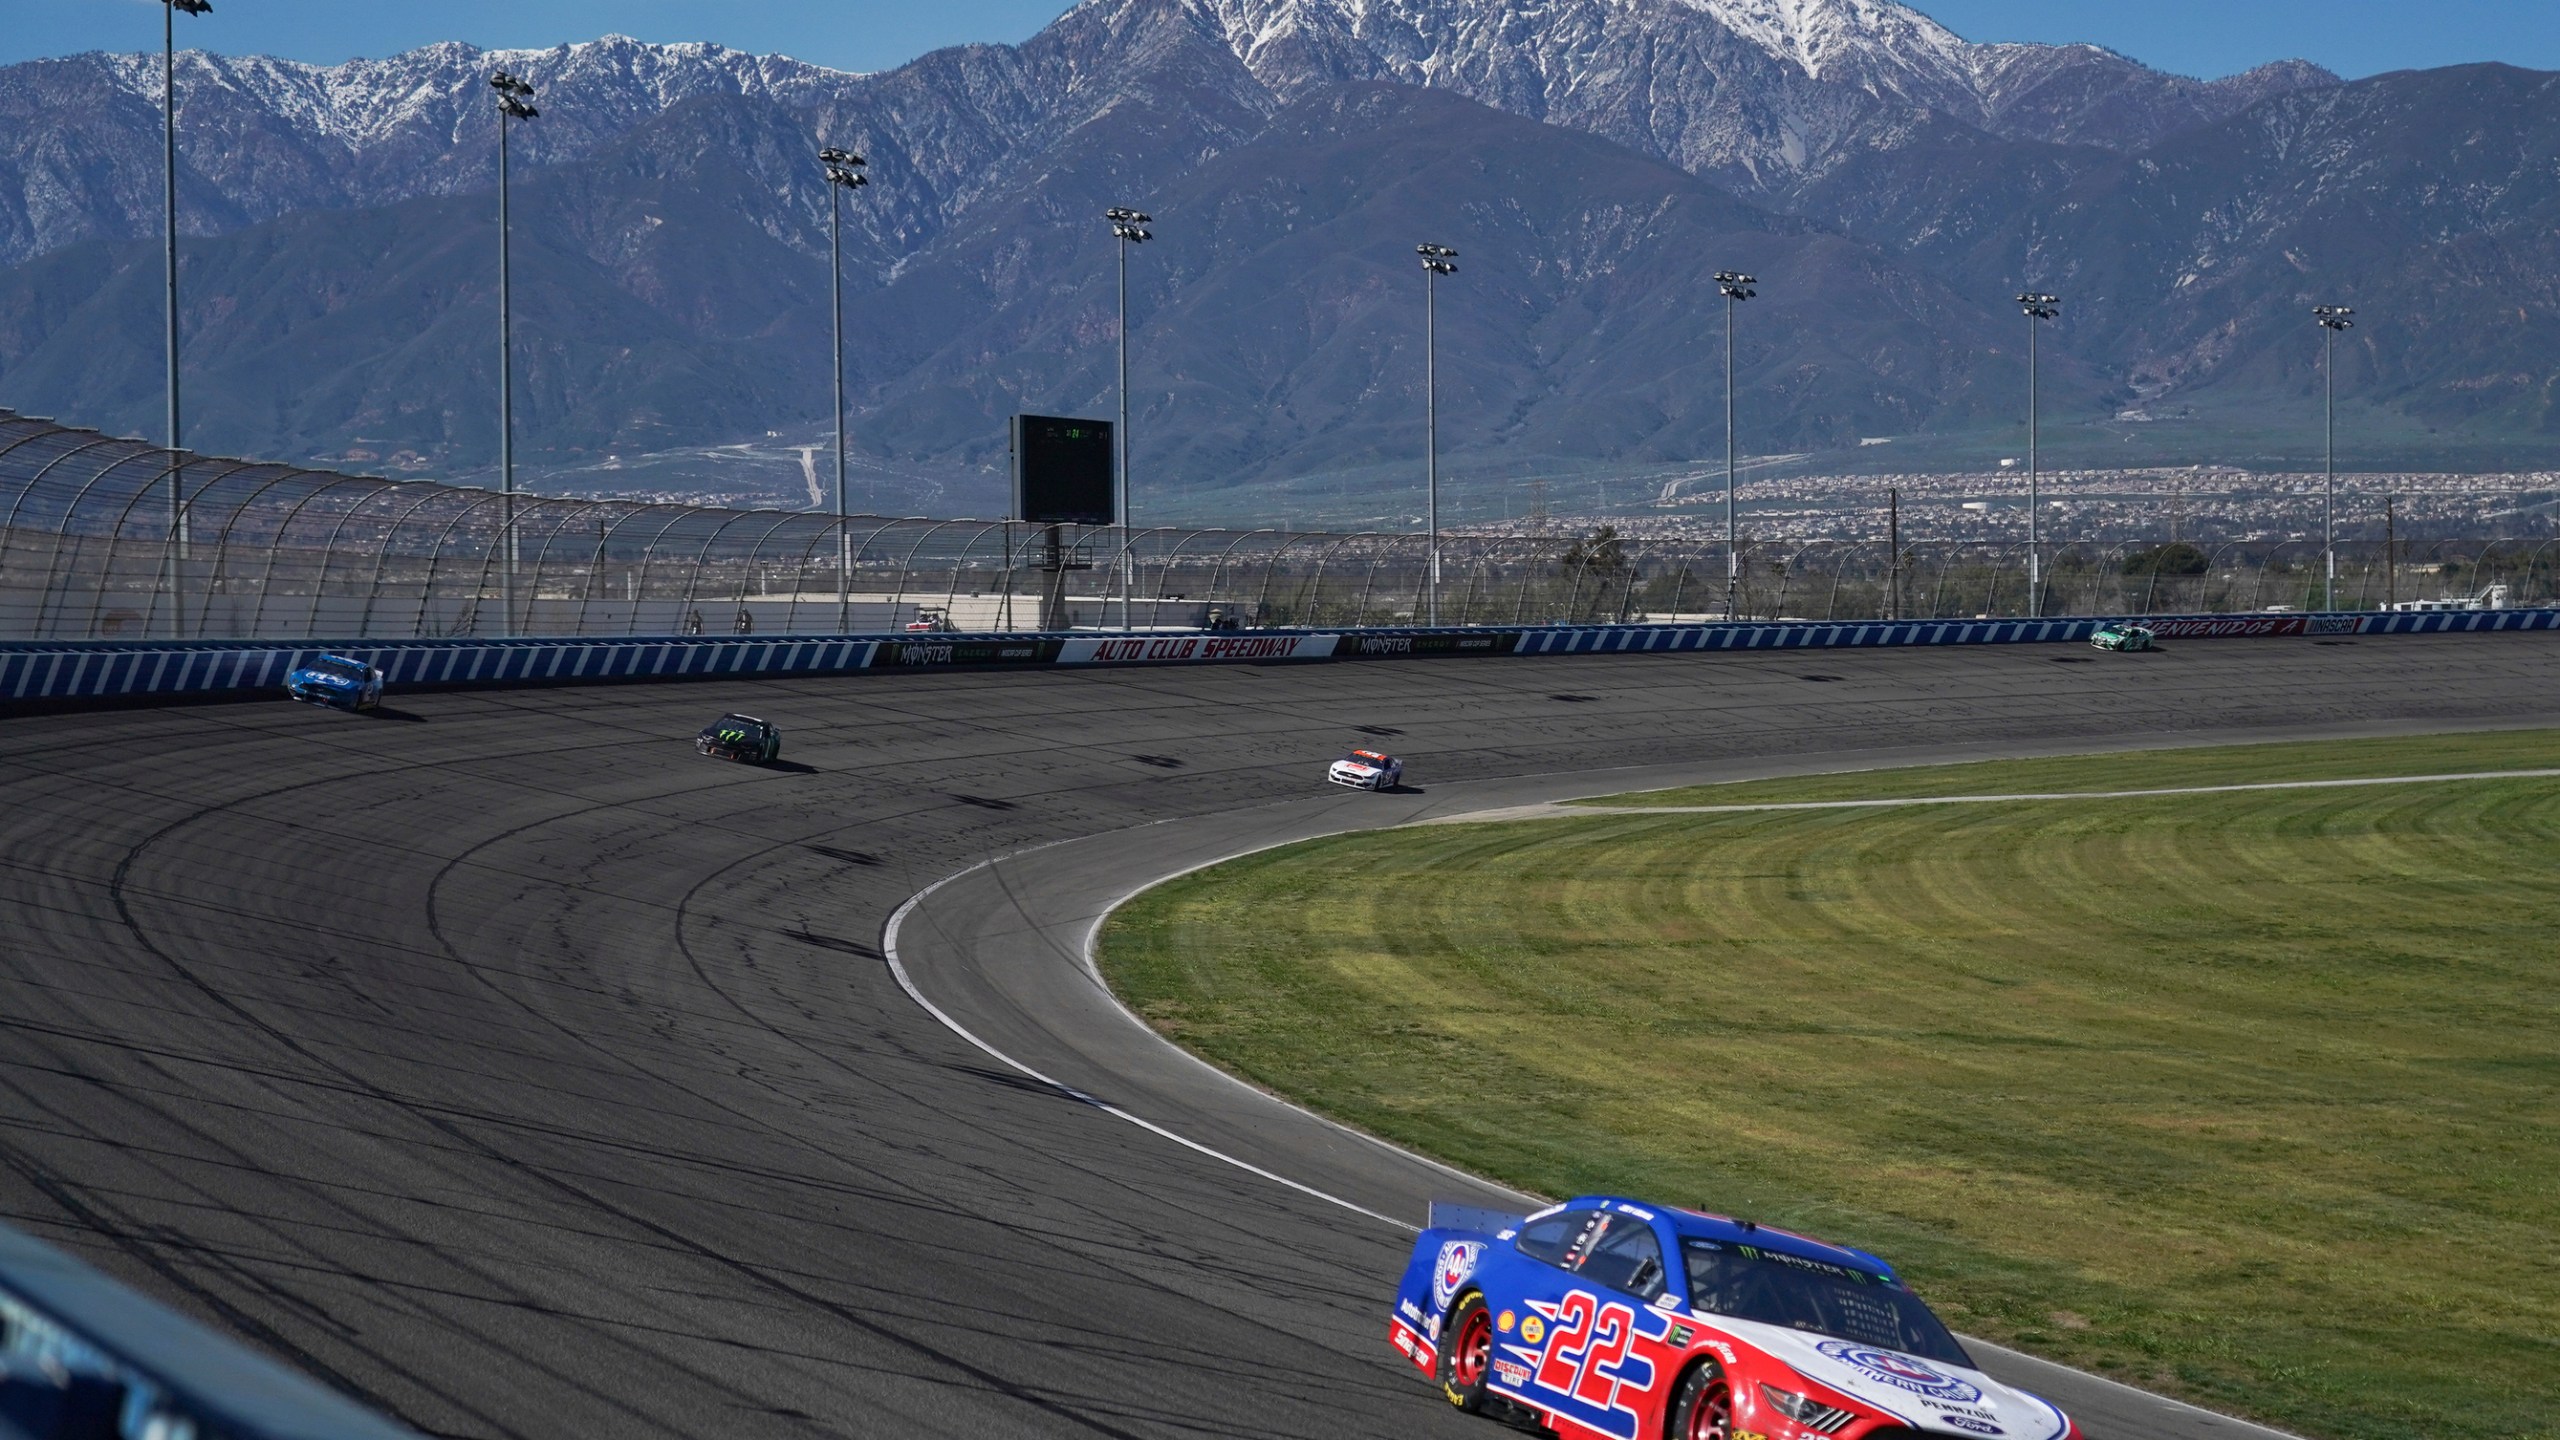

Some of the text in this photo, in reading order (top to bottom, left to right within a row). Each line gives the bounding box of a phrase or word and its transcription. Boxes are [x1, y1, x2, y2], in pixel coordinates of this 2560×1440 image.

[2279, 620, 2299, 633] A
[2316, 617, 2356, 633] NASCAR
[900, 642, 953, 665] MONSTER
[1090, 637, 1303, 661] AUTO CLUB SPEEDWAY
[1360, 635, 1412, 654] MONSTER
[1447, 1252, 1466, 1278] AAA
[1763, 1251, 1846, 1277] MONSTER
[1534, 1289, 1635, 1412] 22
[1493, 1358, 1532, 1381] DISCOUNT
[1503, 1373, 1521, 1387] TIRE
[1920, 1396, 2000, 1423] PENNZOIL
[1953, 1415, 1994, 1433] Ford
